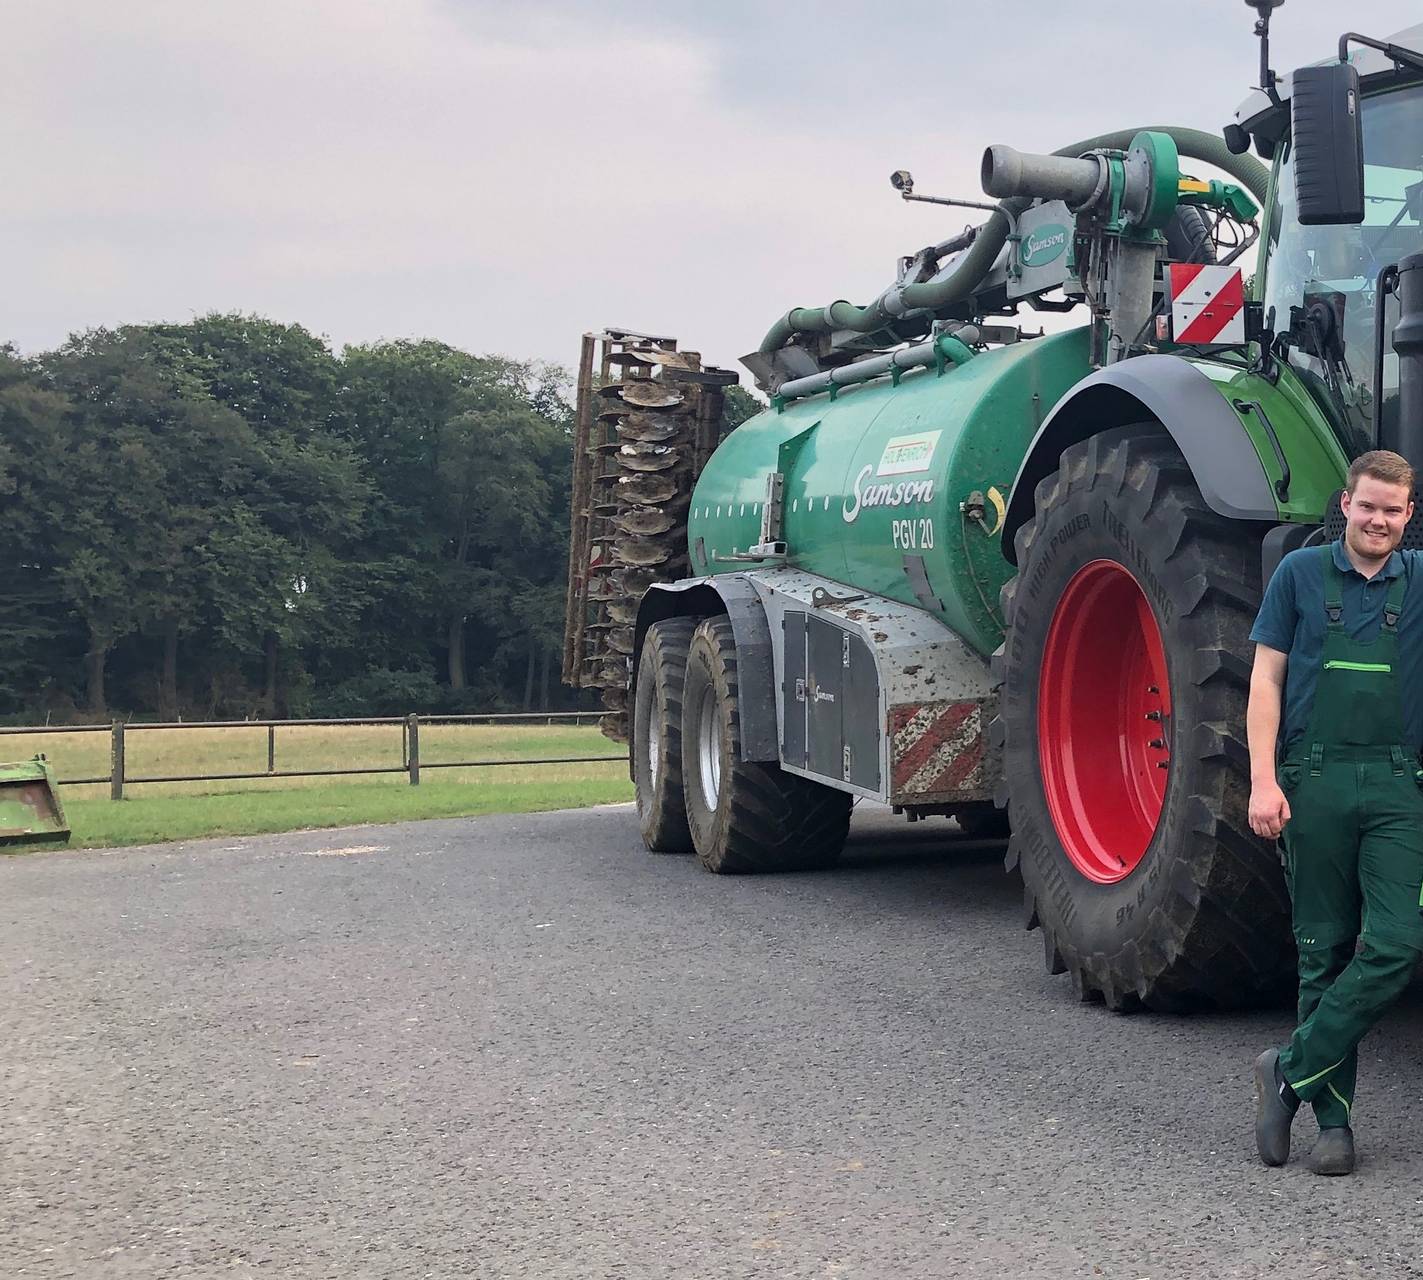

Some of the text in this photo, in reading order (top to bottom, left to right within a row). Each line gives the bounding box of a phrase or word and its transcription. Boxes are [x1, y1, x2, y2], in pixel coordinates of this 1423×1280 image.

[1023, 232, 1064, 260] Samson
[842, 464, 934, 523] Samson
[892, 518, 934, 549] PGV 20
